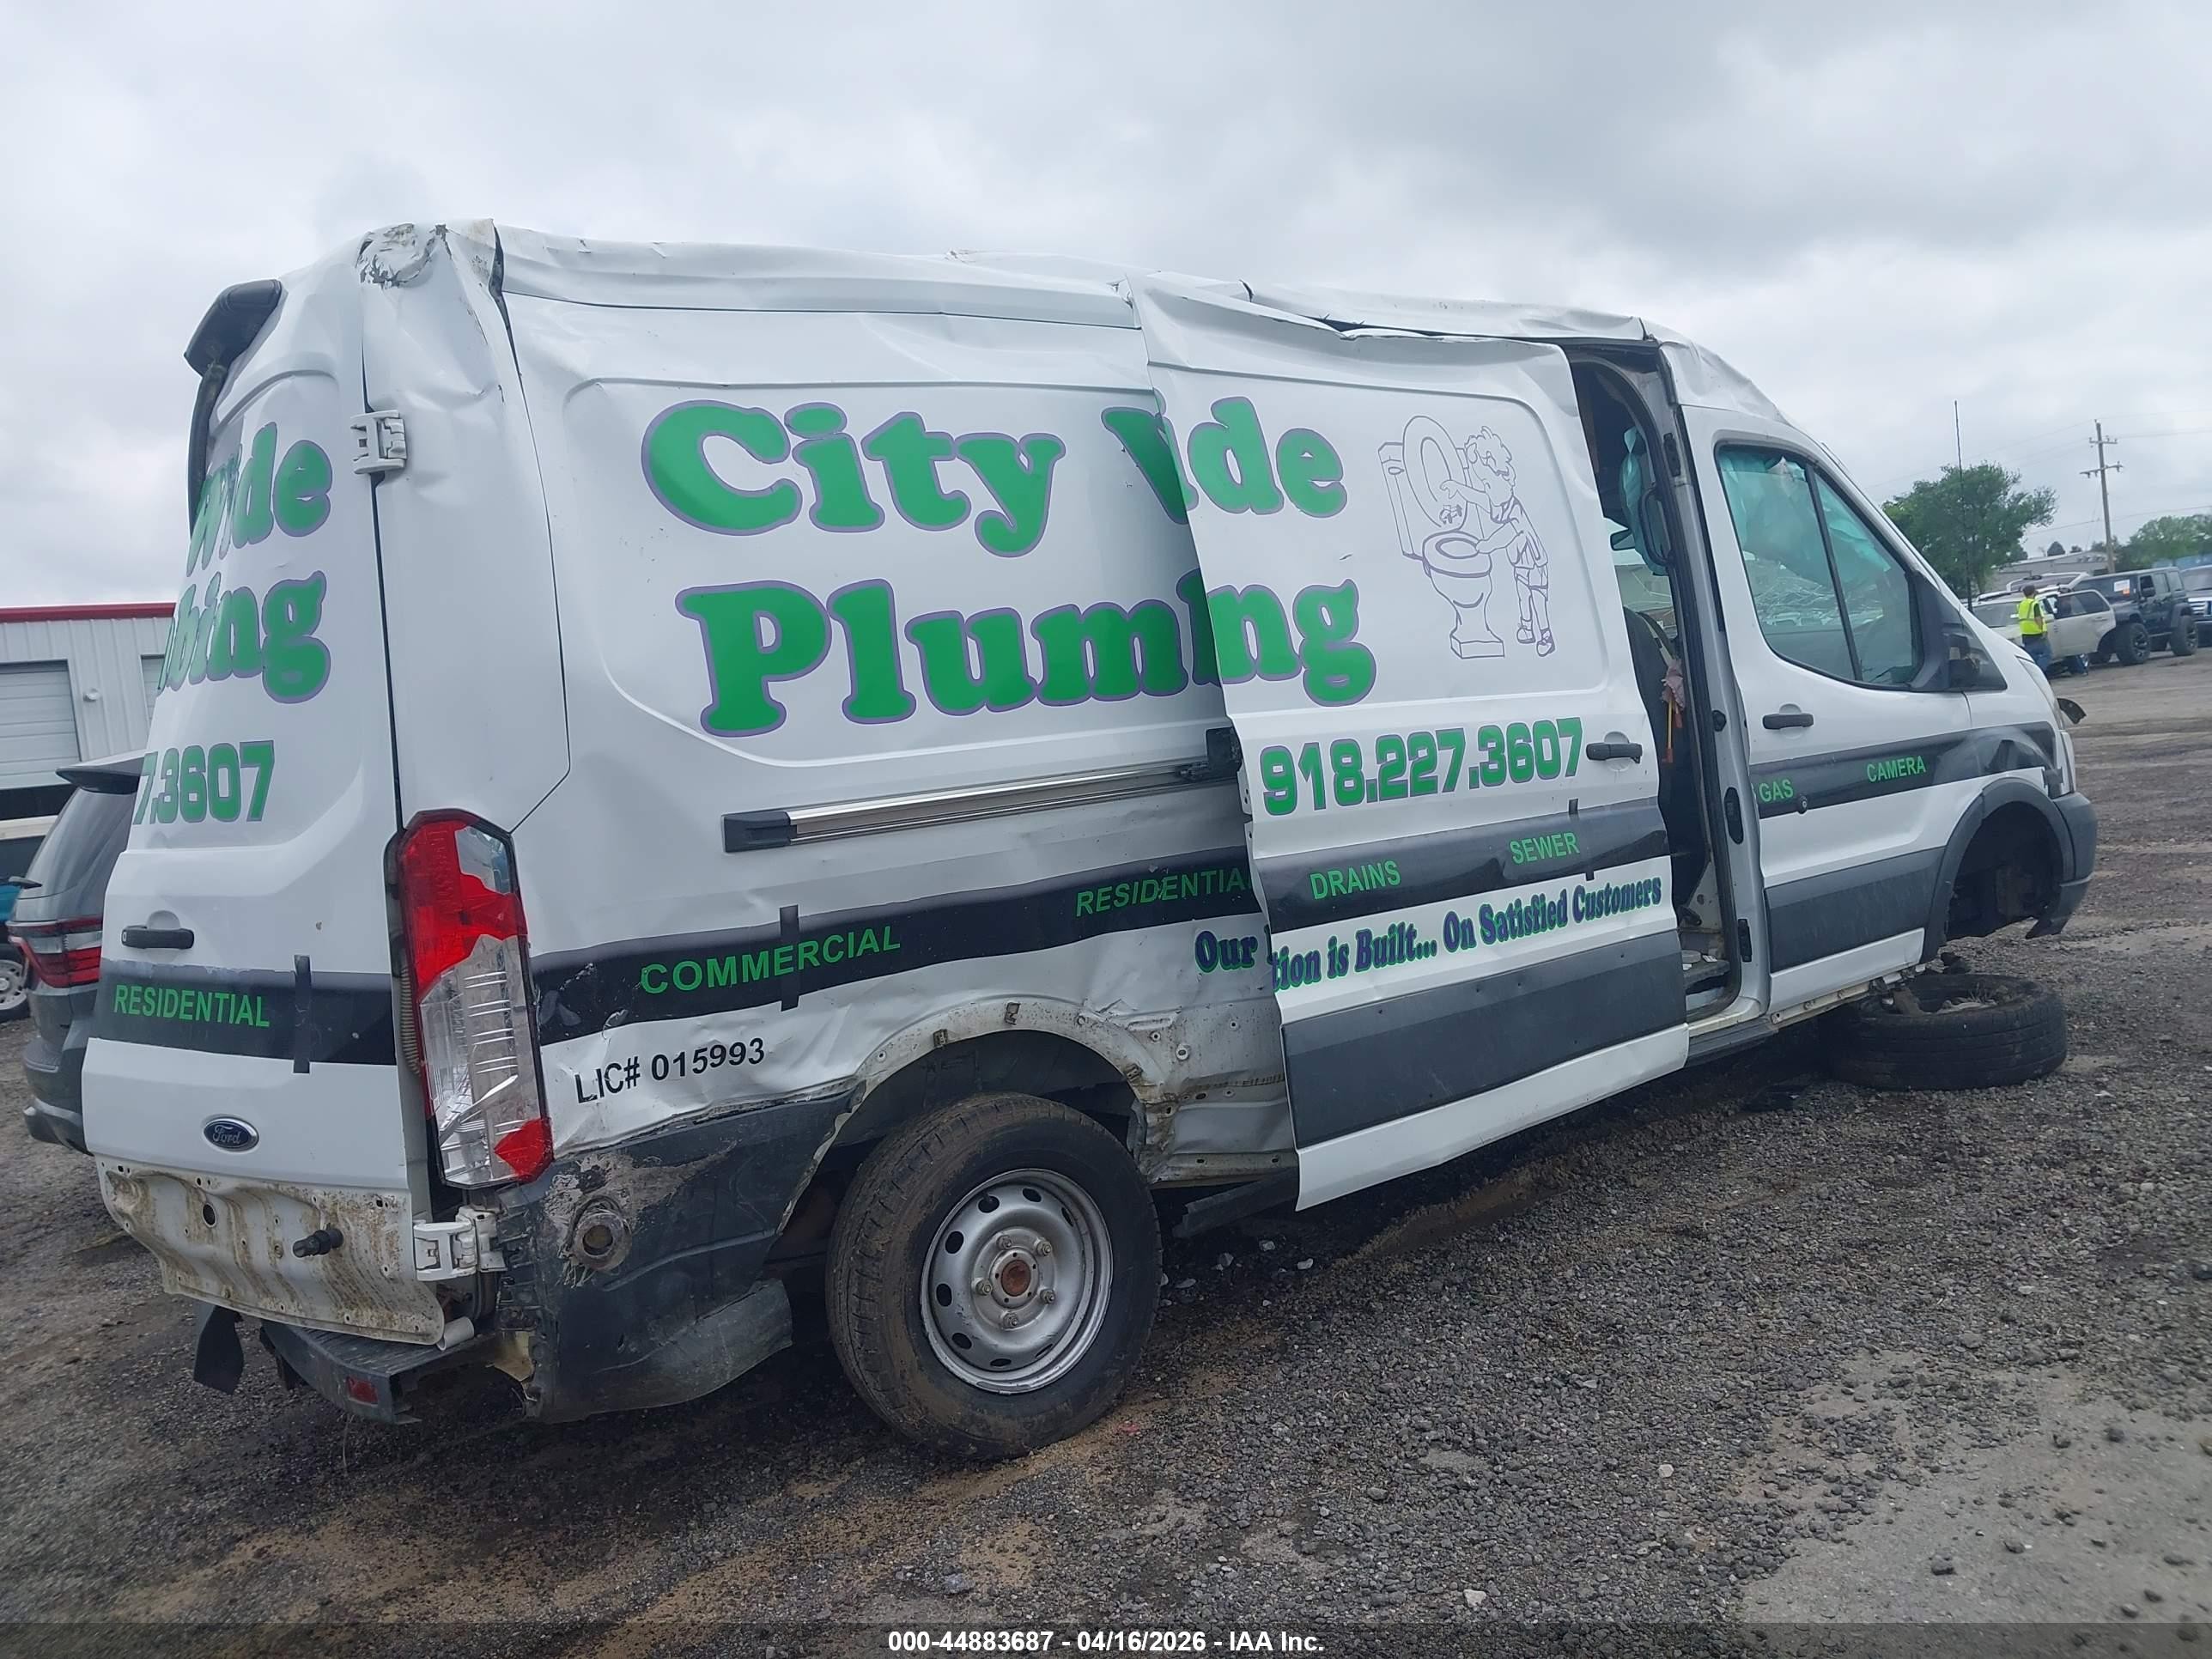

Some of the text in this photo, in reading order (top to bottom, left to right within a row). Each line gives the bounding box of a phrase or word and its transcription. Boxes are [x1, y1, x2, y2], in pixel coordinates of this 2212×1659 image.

[641, 399, 1066, 557] City
[156, 571, 331, 704] bing
[1260, 716, 1583, 816] 918.227.3607
[1759, 779, 1794, 802] GAS
[1867, 755, 1926, 782] CAMERA
[1510, 832, 1580, 866] SEWER
[1076, 867, 1251, 917] RESIDENTIA
[1310, 860, 1401, 900] DRAINS
[640, 926, 901, 994] COMMERCIAL
[1194, 877, 1662, 993] Our tion is Built... On Satisfied Customers
[114, 984, 270, 1028] RESIDENTIAL
[574, 1037, 764, 1103] LIC# 015993
[212, 1124, 241, 1144] Ford
